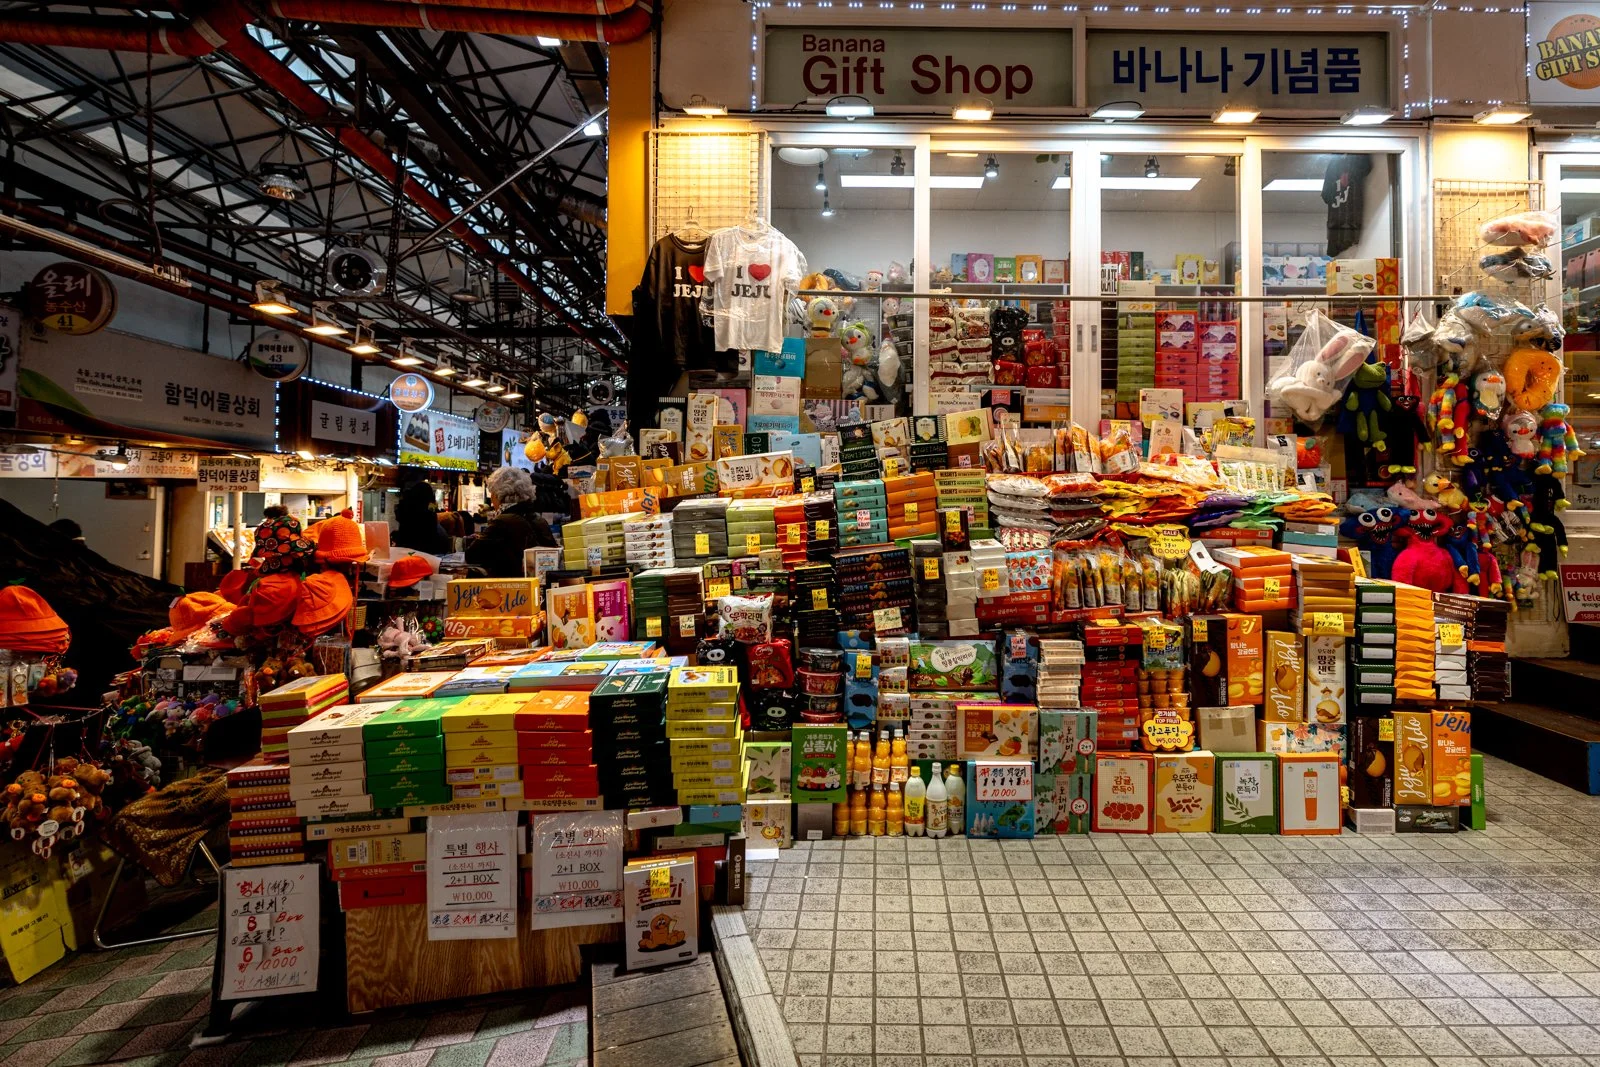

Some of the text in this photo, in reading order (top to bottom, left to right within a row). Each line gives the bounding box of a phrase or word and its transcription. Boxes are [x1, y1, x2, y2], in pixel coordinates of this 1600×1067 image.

[802, 34, 886, 53] Banana
[1537, 26, 1600, 60] BANA
[1536, 52, 1583, 81] GIFT
[801, 55, 1034, 101] Gift Shop
[674, 266, 682, 280] I
[736, 265, 743, 279] I
[35, 269, 92, 299] 올레
[58, 315, 73, 327] 41
[269, 354, 282, 362] 43
[164, 382, 261, 418] 함덕어물상회
[447, 434, 476, 455] 오메기떡
[149, 451, 174, 463] 고등어
[198, 469, 260, 483] 함덕어물상회
[453, 584, 485, 611] Jeju
[1567, 591, 1581, 602] kt
[1147, 725, 1180, 737] 망고푸딩
[803, 740, 838, 753] 삼총사
[1113, 775, 1132, 786] 감귤
[1171, 773, 1199, 783] 우도땅콩
[1239, 776, 1257, 786] 녹차
[553, 829, 607, 844] 특별 행사
[444, 841, 500, 857] 특별 행사
[556, 862, 601, 875] 2+1 BOX
[450, 874, 494, 885] 2+1 BOX
[247, 915, 257, 931] 8
[243, 946, 253, 963] 6
